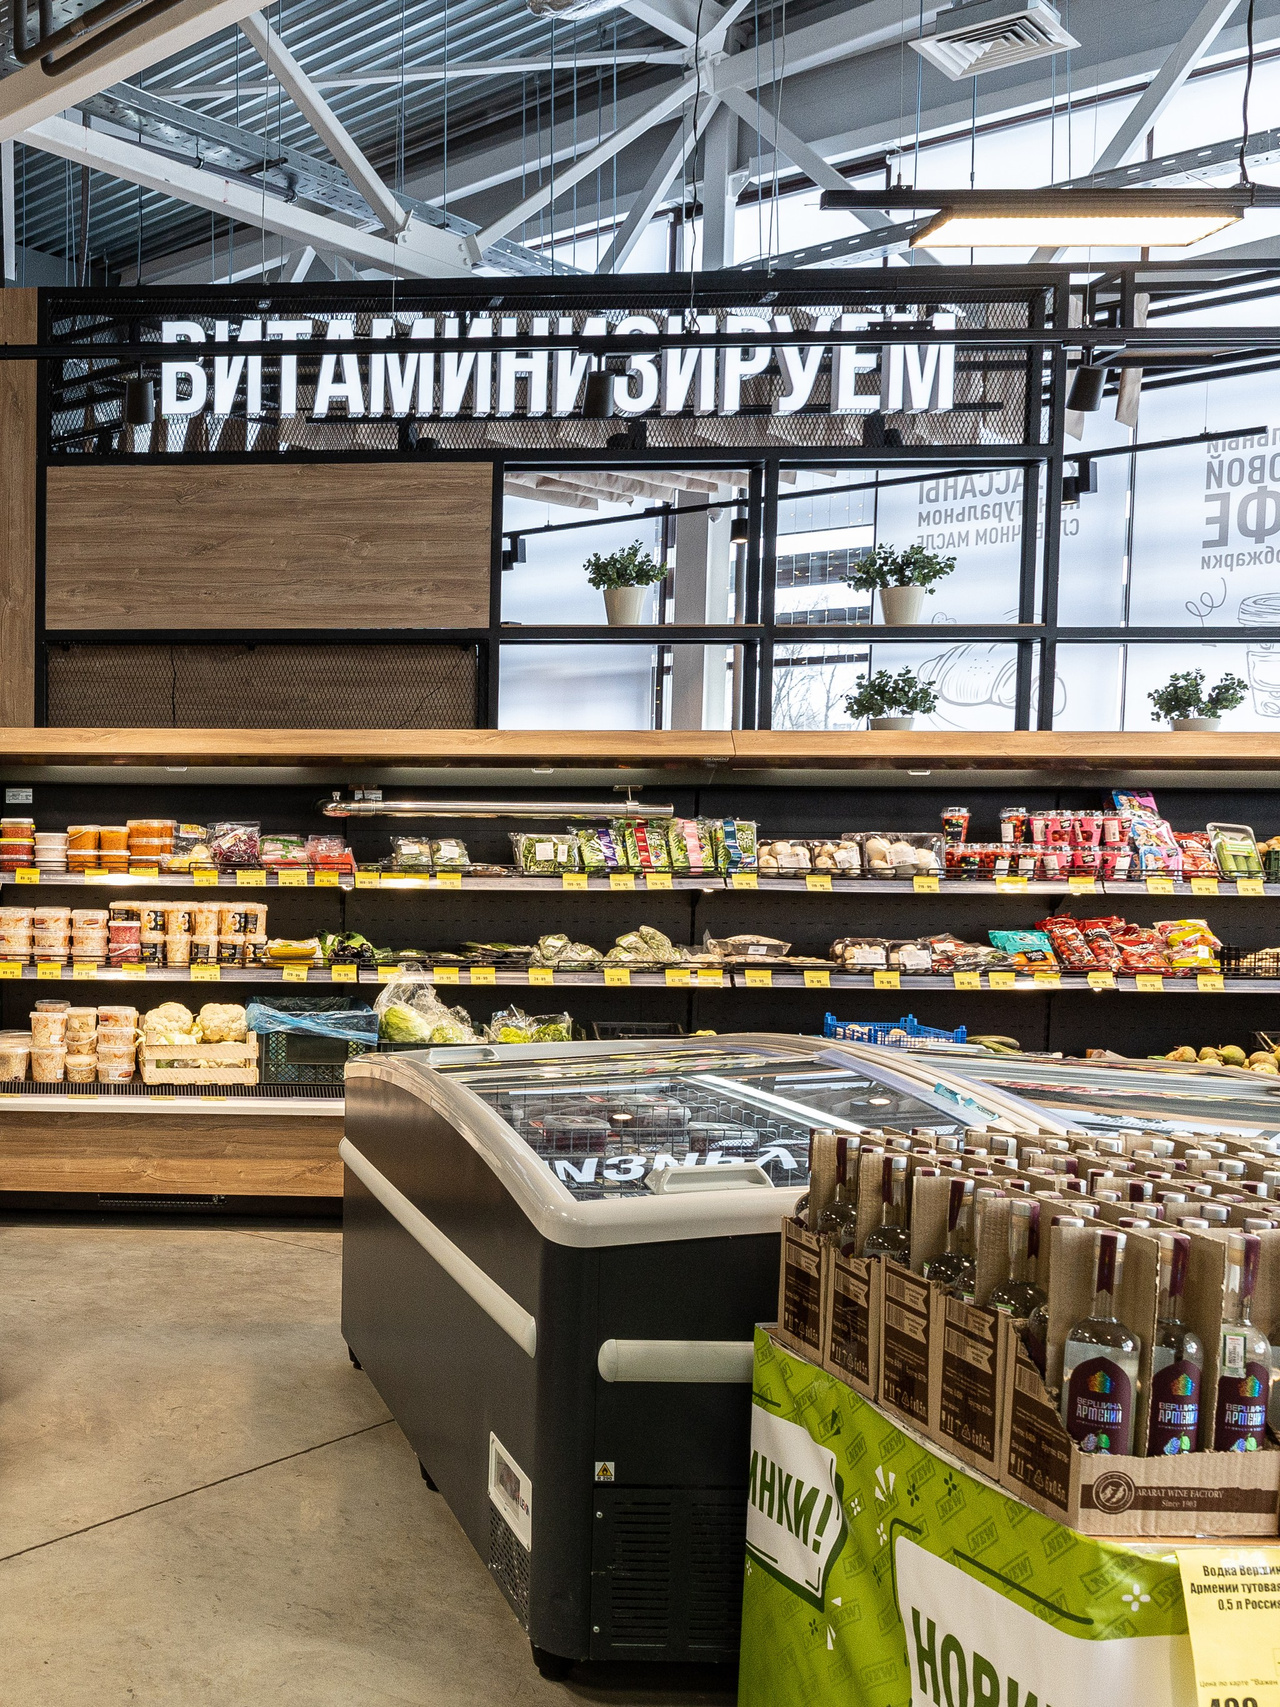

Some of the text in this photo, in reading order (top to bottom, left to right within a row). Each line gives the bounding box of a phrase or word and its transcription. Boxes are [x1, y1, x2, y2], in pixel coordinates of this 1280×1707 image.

[161, 309, 957, 416] ВИТАМИНИЗИРУЕМ
[1076, 1404, 1122, 1423] АРМЕНИИ
[1136, 1489, 1225, 1499] ARARAT WINE FACTORY
[1161, 1500, 1180, 1508] Since
[1202, 1565, 1237, 1577] Водка
[1190, 1582, 1239, 1595] Армении
